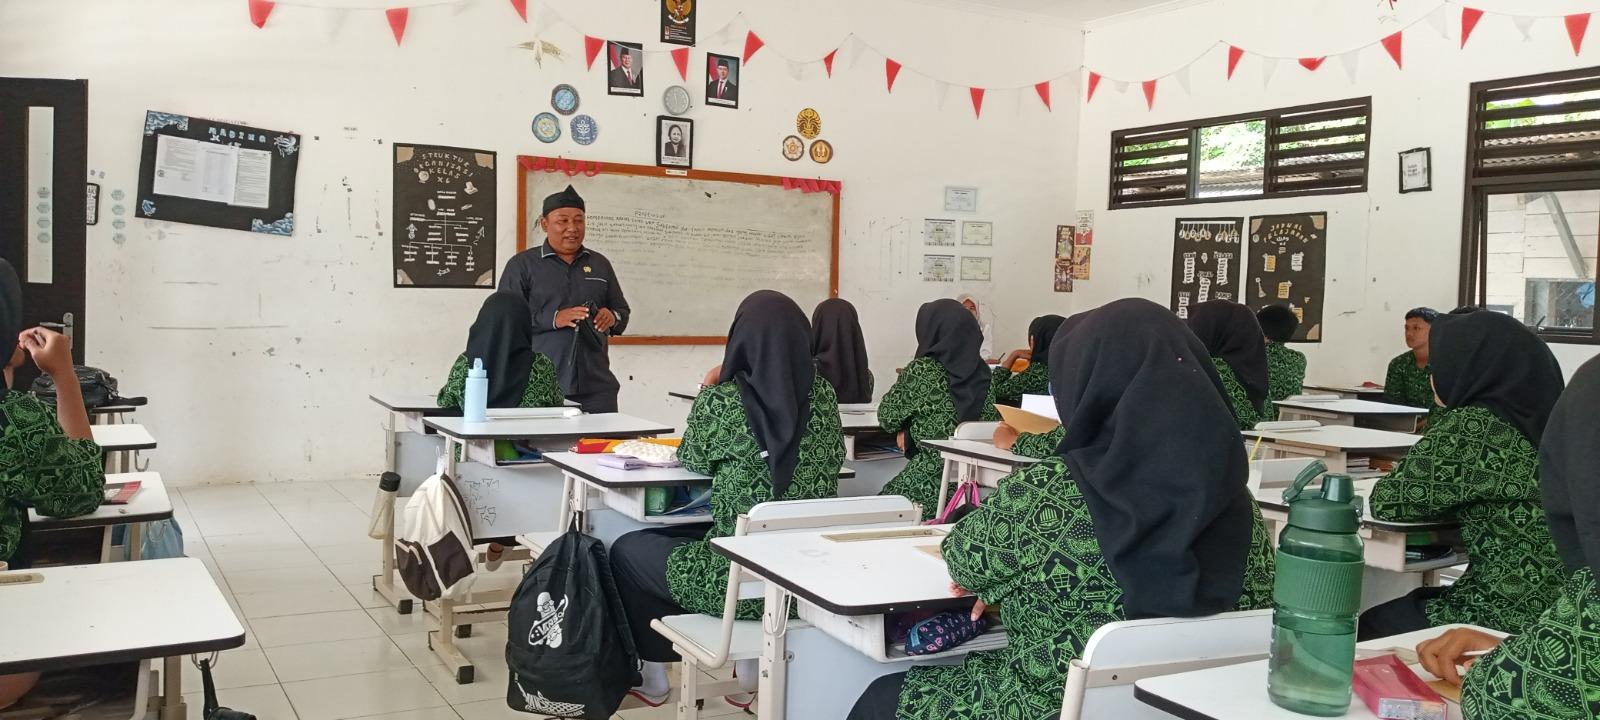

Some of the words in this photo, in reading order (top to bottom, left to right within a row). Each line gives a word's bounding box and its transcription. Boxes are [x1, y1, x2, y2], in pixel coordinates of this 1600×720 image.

[208, 127, 266, 143] MADING
[422, 153, 469, 167] STRUKTUR
[413, 160, 473, 177] ORGANISASI
[428, 168, 460, 179] KELAS
[1270, 223, 1303, 232] JADWAL
[1264, 229, 1309, 243] PELAJARAN
